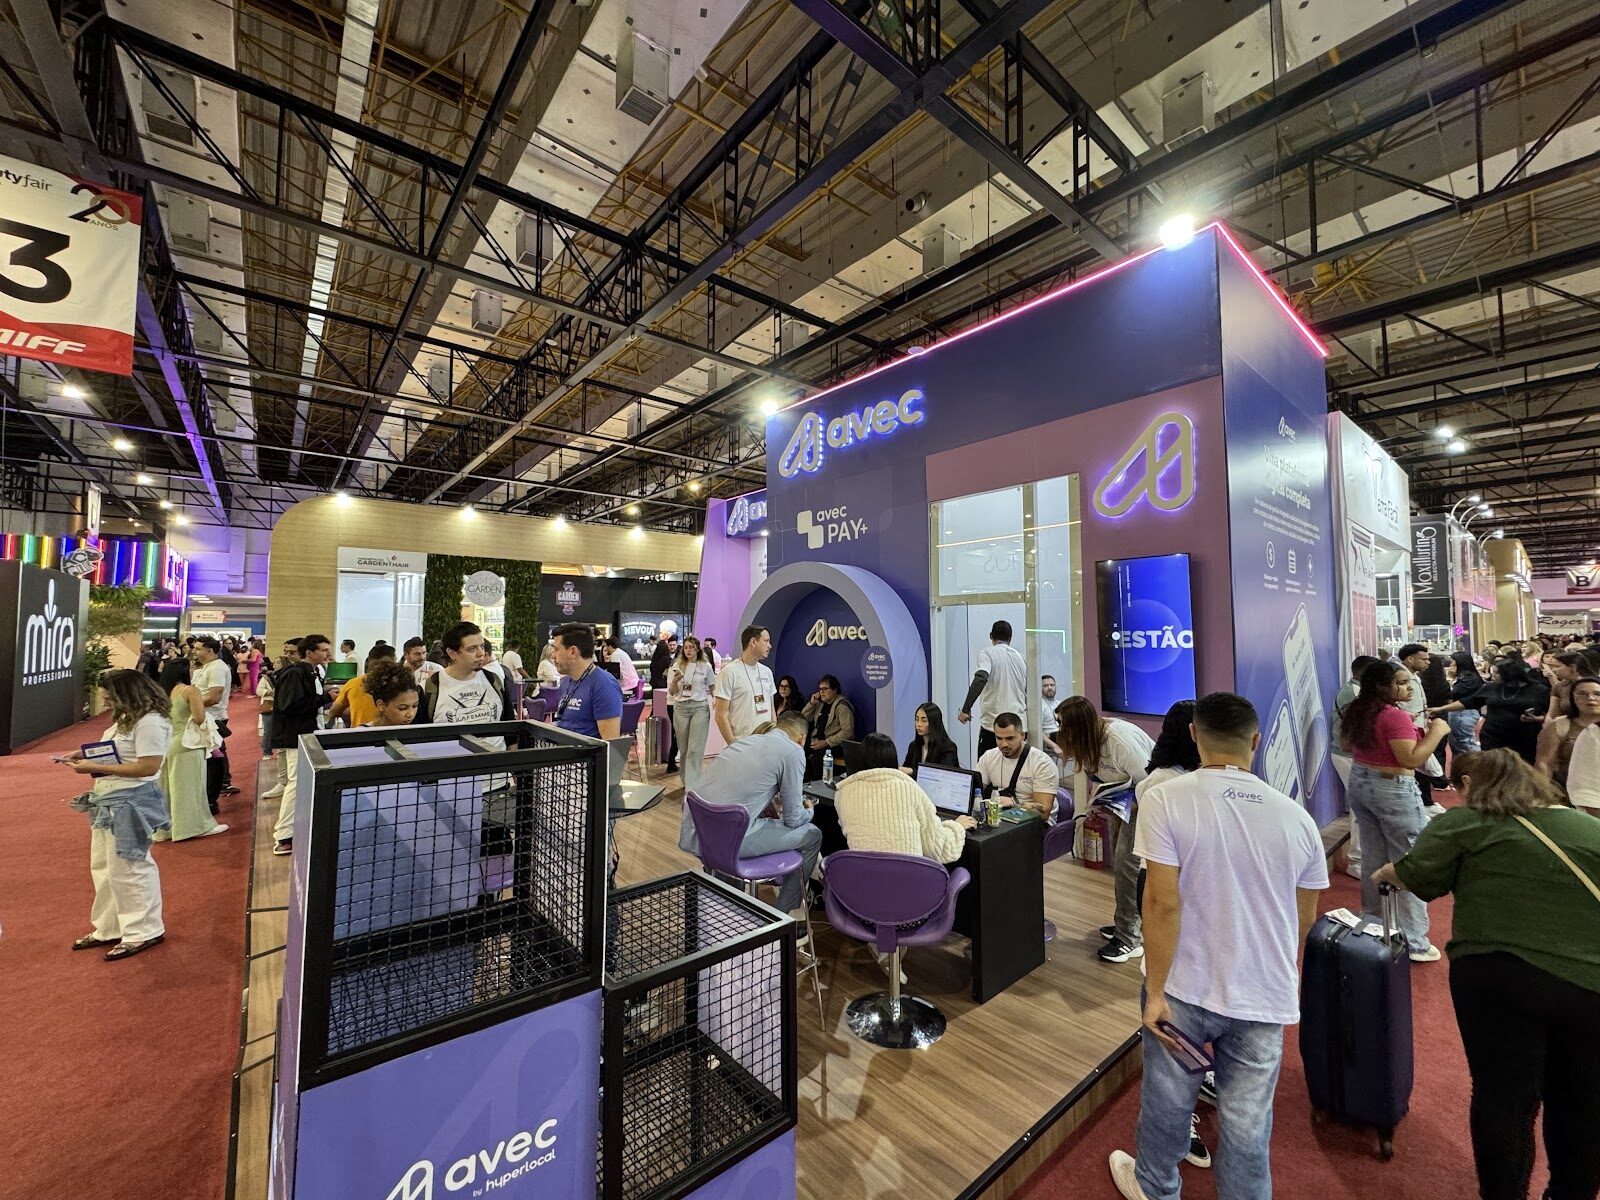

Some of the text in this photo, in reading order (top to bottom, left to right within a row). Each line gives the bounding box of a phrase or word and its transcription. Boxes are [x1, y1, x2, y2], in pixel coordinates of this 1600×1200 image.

[89, 218, 119, 231] ANOS
[826, 389, 924, 449] avec
[816, 504, 847, 521] avec
[357, 559, 388, 567] GARDEN
[1575, 575, 1590, 587] B
[467, 584, 502, 594] GARDEN
[557, 591, 580, 601] GARDEN
[1538, 616, 1584, 627] Roger
[827, 623, 868, 640] avec
[23, 614, 74, 674] mira
[22, 669, 73, 686] PROFESSIONAL
[1237, 791, 1263, 801] avec
[444, 1118, 558, 1191] avec
[472, 1148, 557, 1197] by hyperlocal
